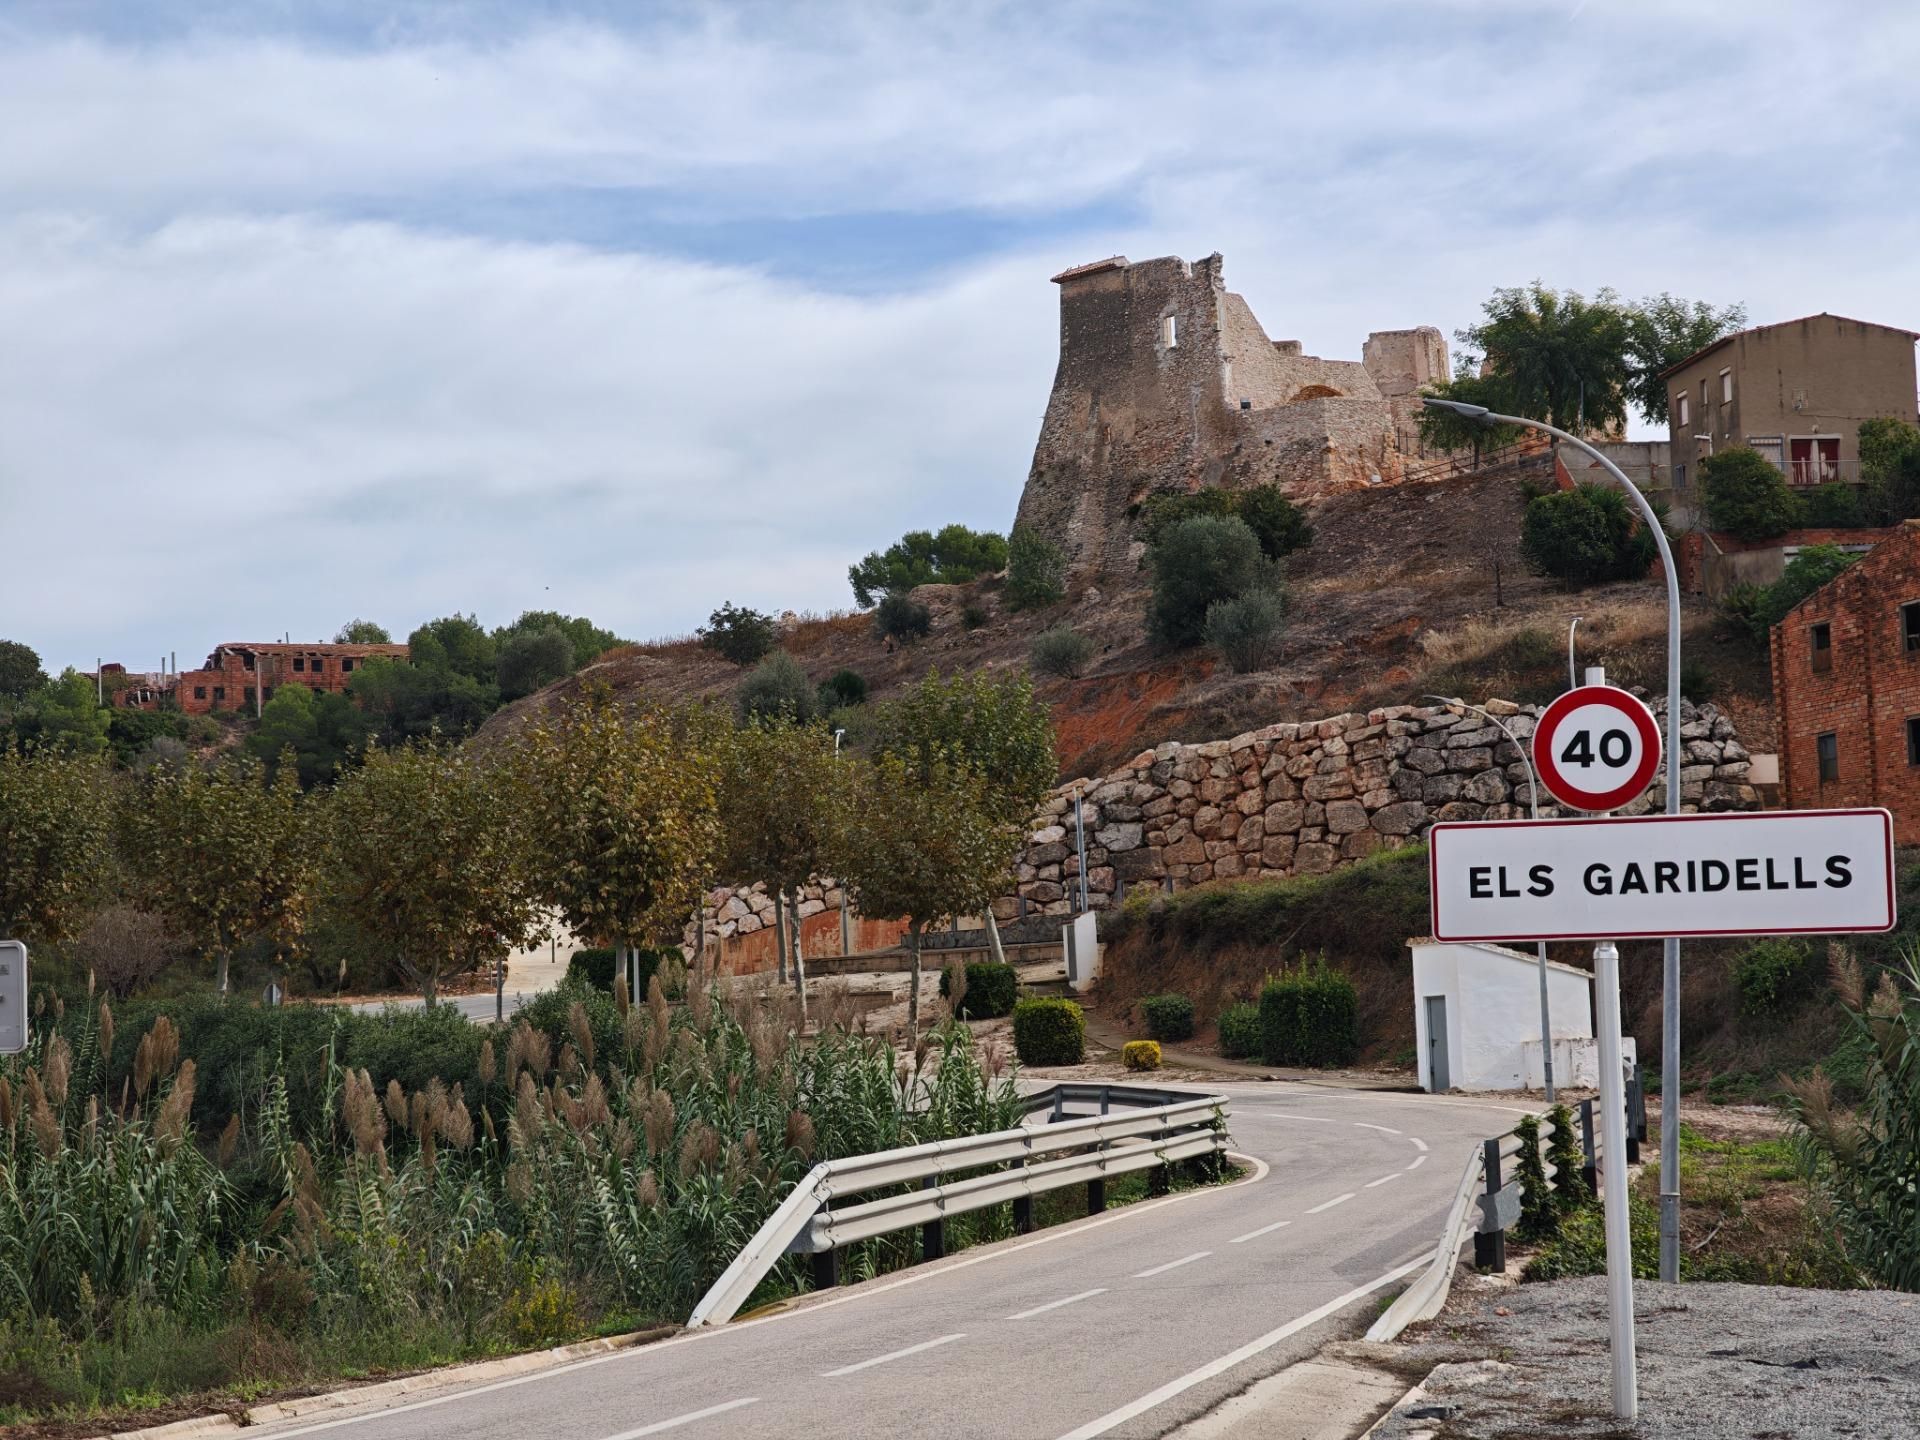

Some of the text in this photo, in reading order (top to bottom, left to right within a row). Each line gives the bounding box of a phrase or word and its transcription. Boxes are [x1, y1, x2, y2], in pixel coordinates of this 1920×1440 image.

[1561, 729, 1632, 768] 40
[1469, 854, 1853, 899] ELS GARIDELLS
